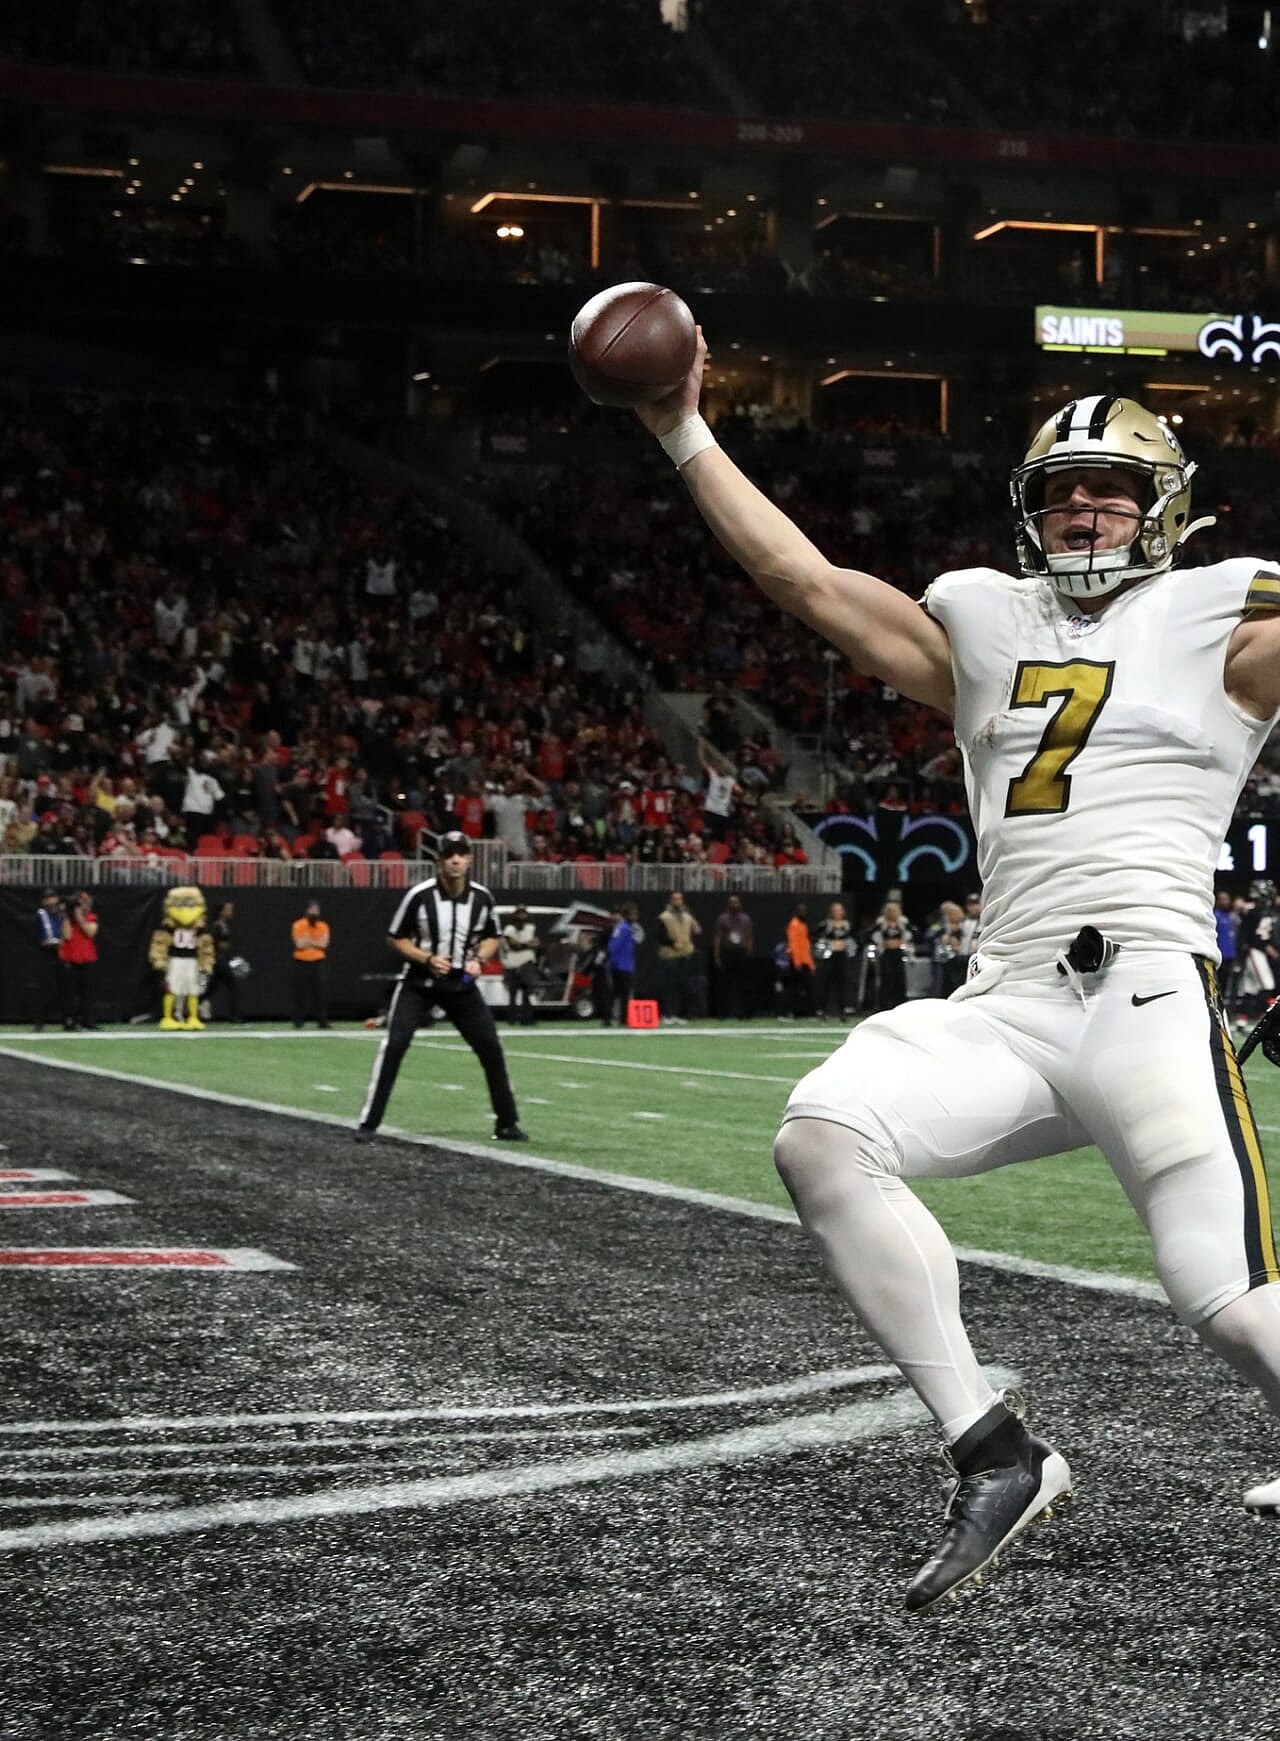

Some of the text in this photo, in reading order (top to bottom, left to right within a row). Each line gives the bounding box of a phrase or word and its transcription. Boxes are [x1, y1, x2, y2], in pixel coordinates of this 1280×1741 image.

[1041, 315, 1125, 346] SAINTS
[1003, 659, 1116, 819] 7
[1247, 824, 1267, 871] 1
[634, 1004, 653, 1025] 10
